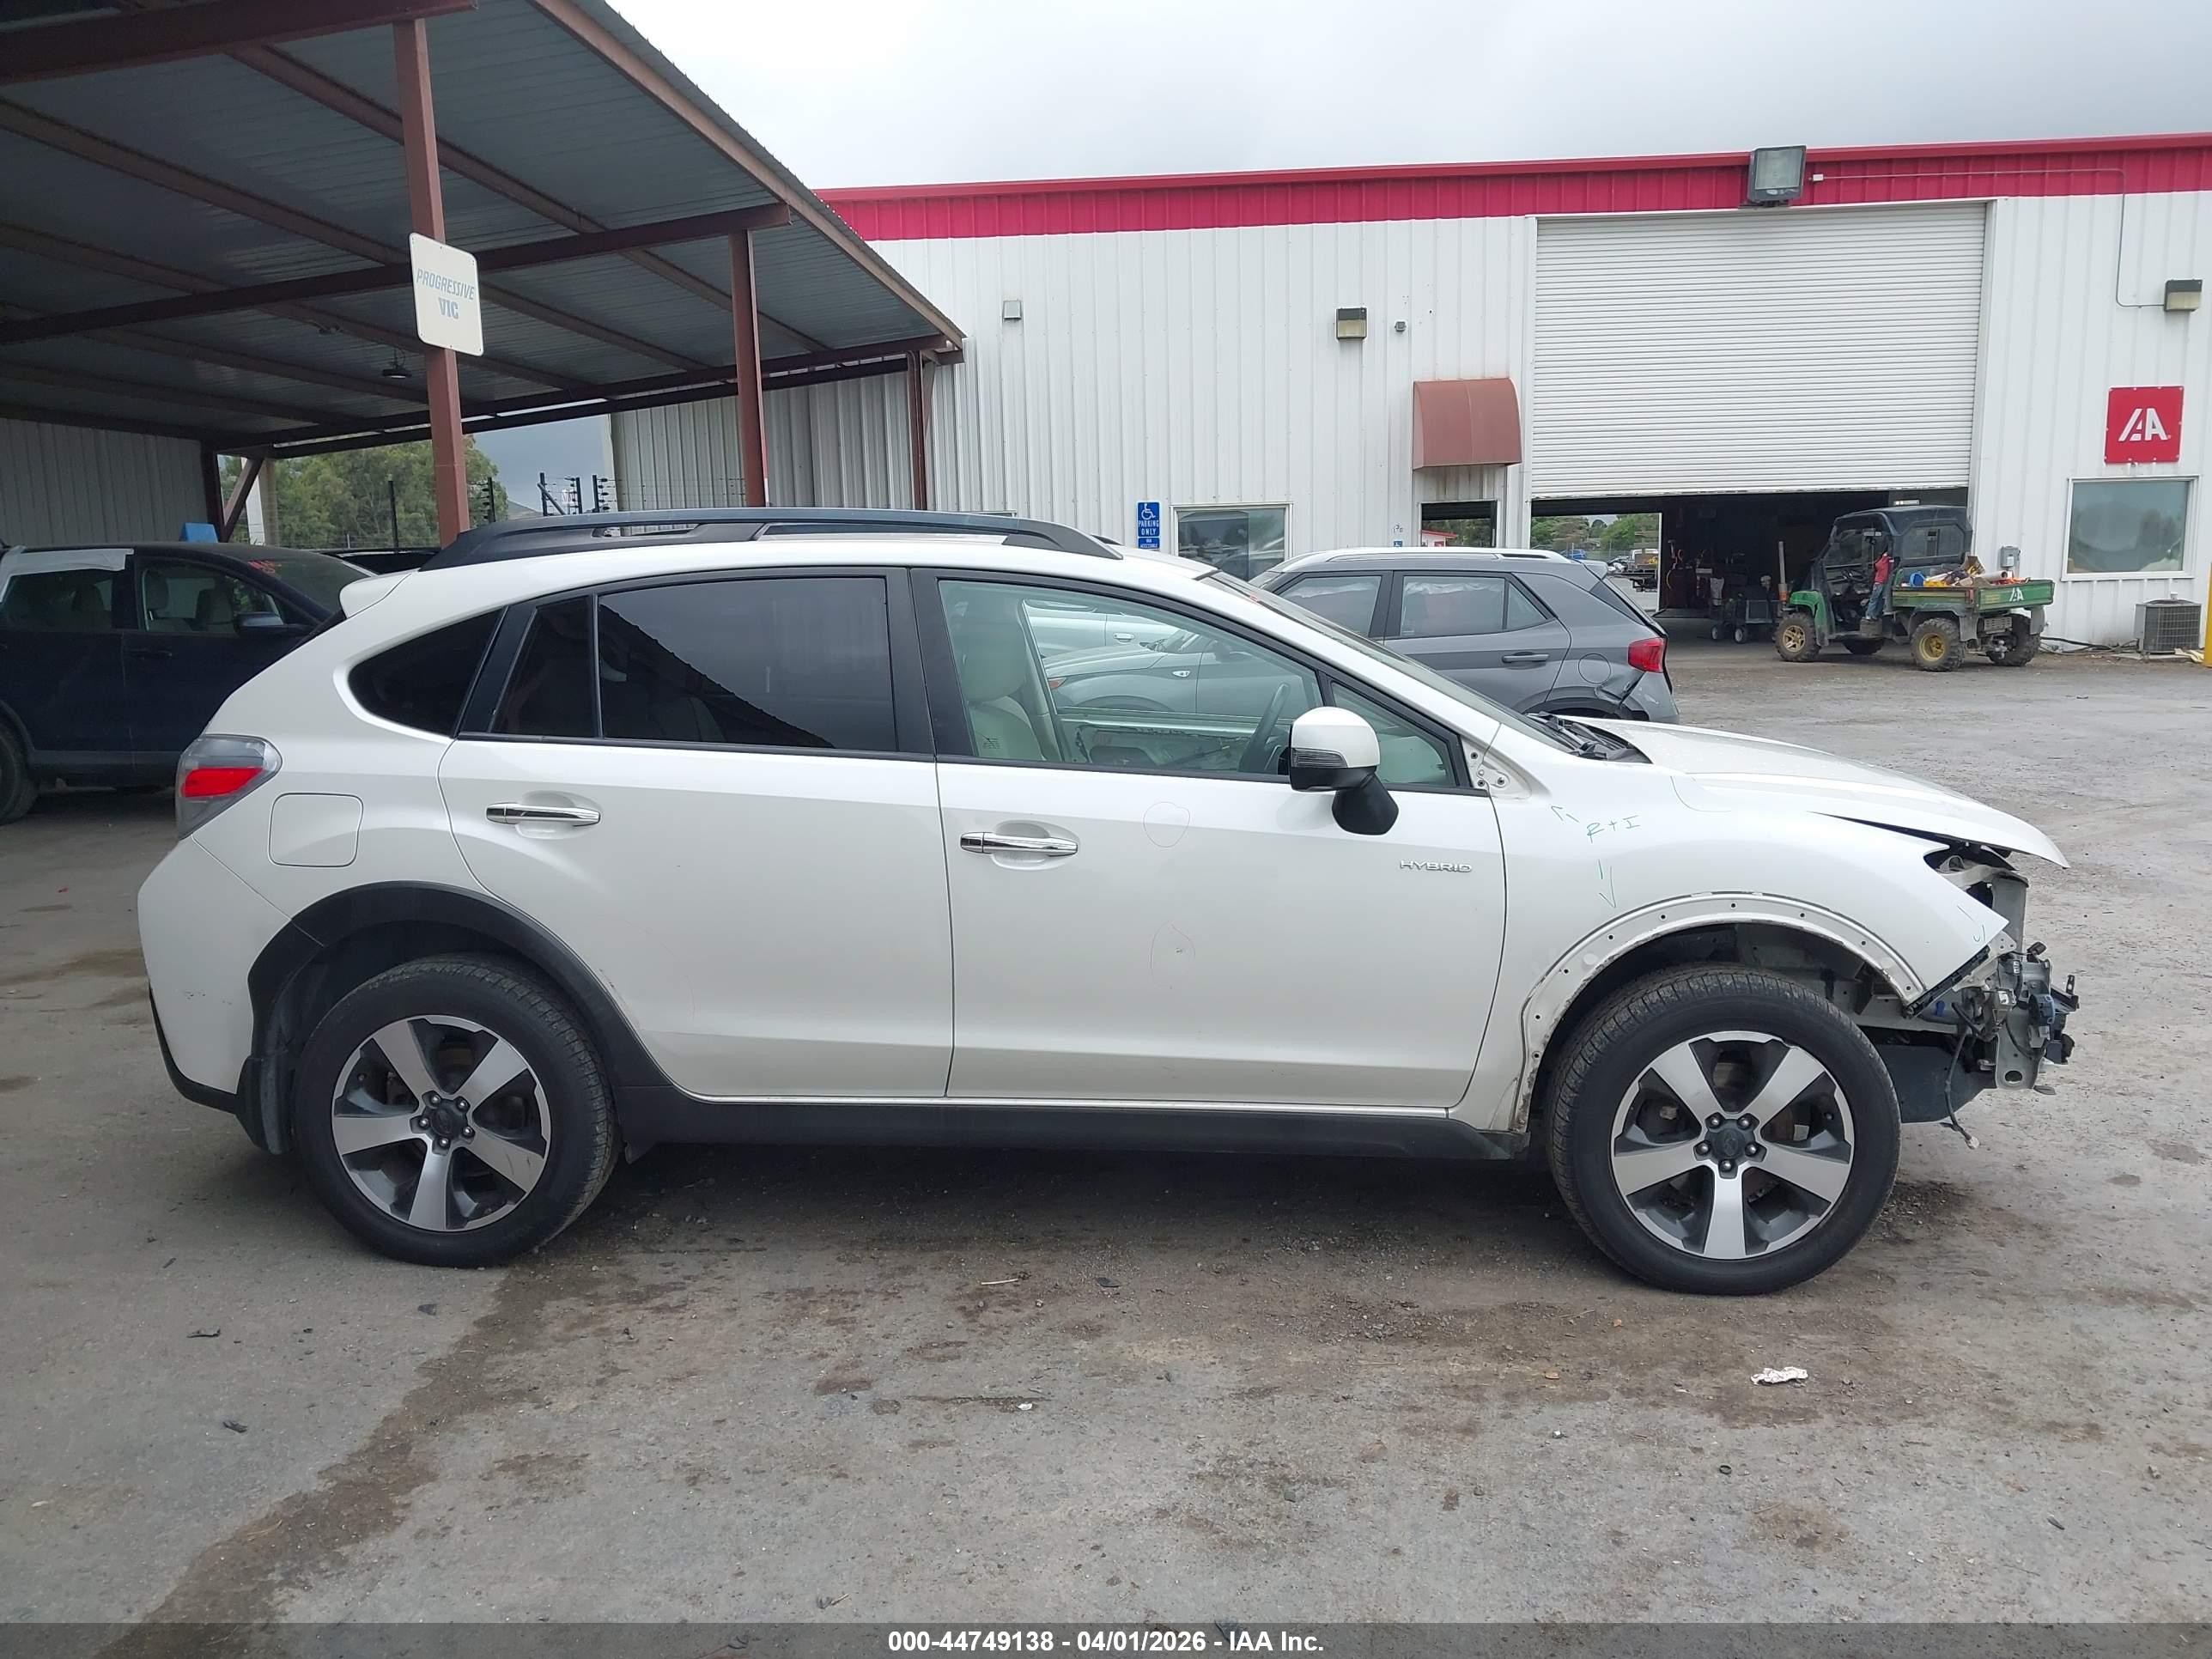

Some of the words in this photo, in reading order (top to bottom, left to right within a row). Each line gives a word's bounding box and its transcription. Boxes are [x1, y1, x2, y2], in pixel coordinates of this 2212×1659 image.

[416, 268, 475, 301] PROGRESSIVE
[438, 297, 459, 319] VIC
[1401, 860, 1472, 872] HYBRID
